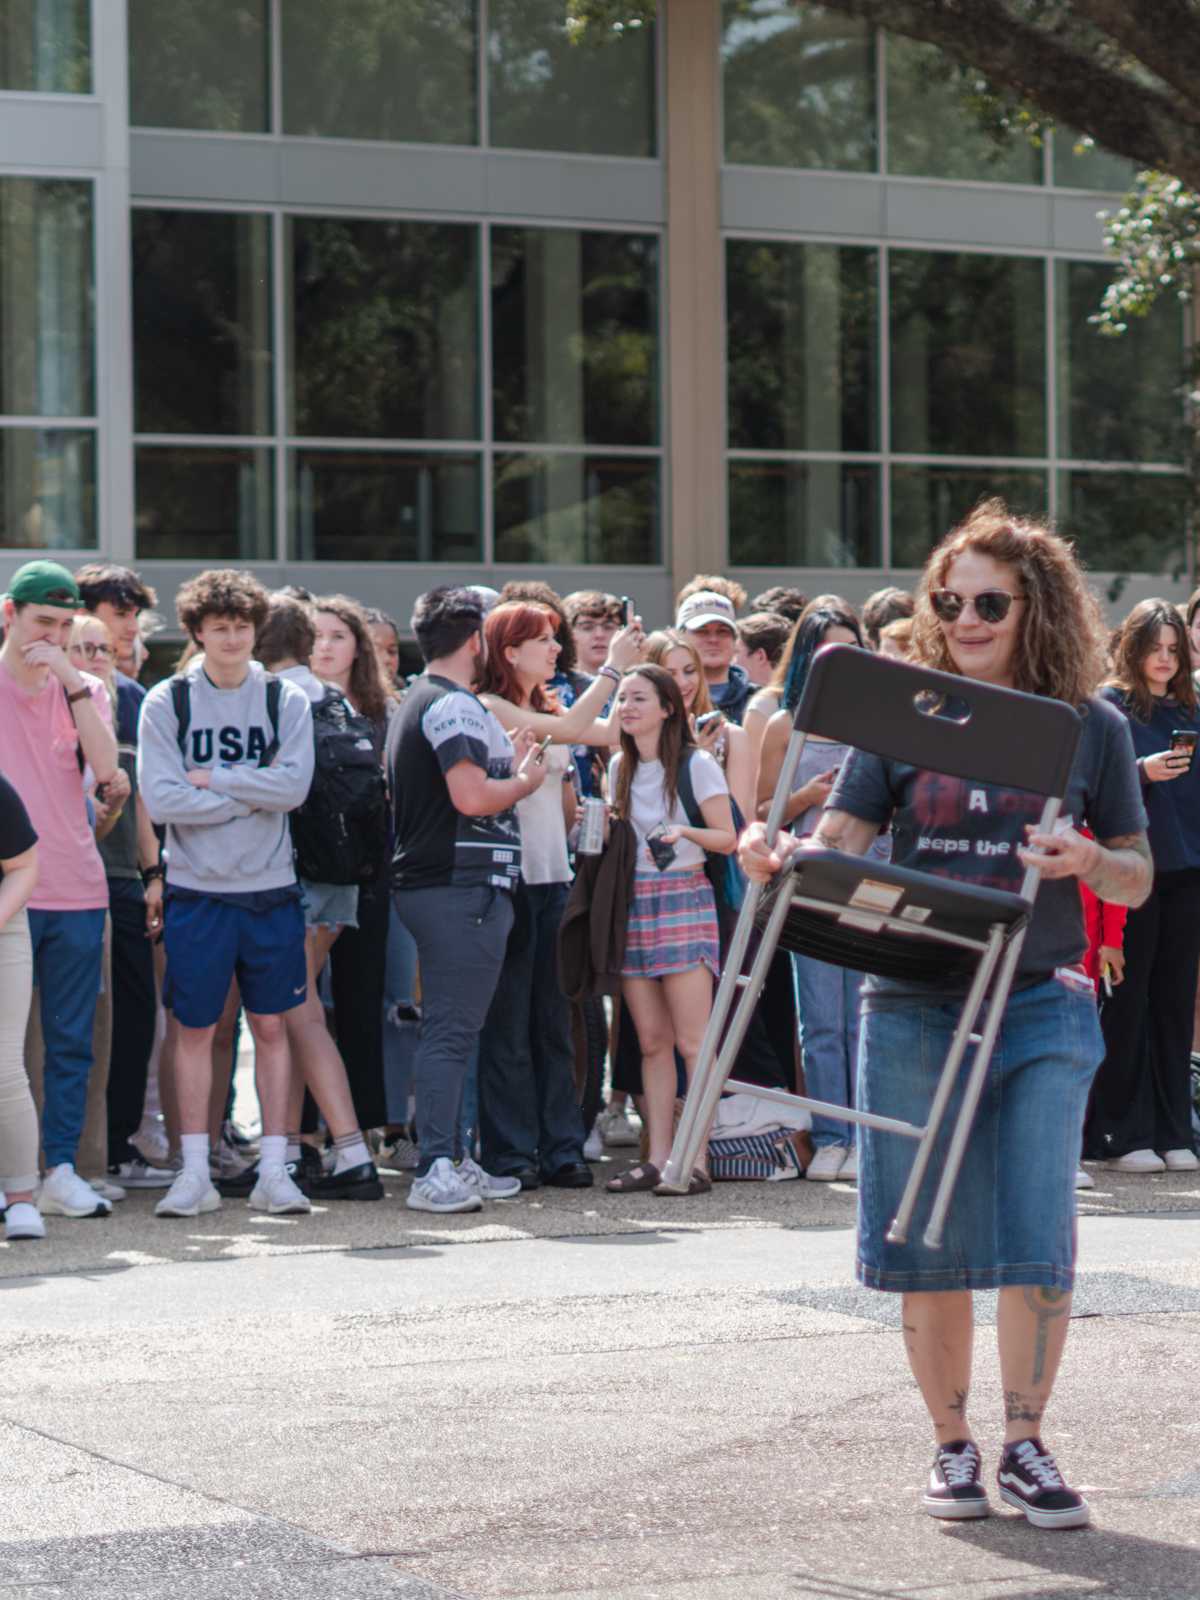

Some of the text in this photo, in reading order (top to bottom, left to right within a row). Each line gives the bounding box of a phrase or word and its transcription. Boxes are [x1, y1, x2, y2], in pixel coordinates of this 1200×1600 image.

[192, 726, 267, 763] USA
[968, 789, 988, 812] A
[976, 841, 1010, 856] the
